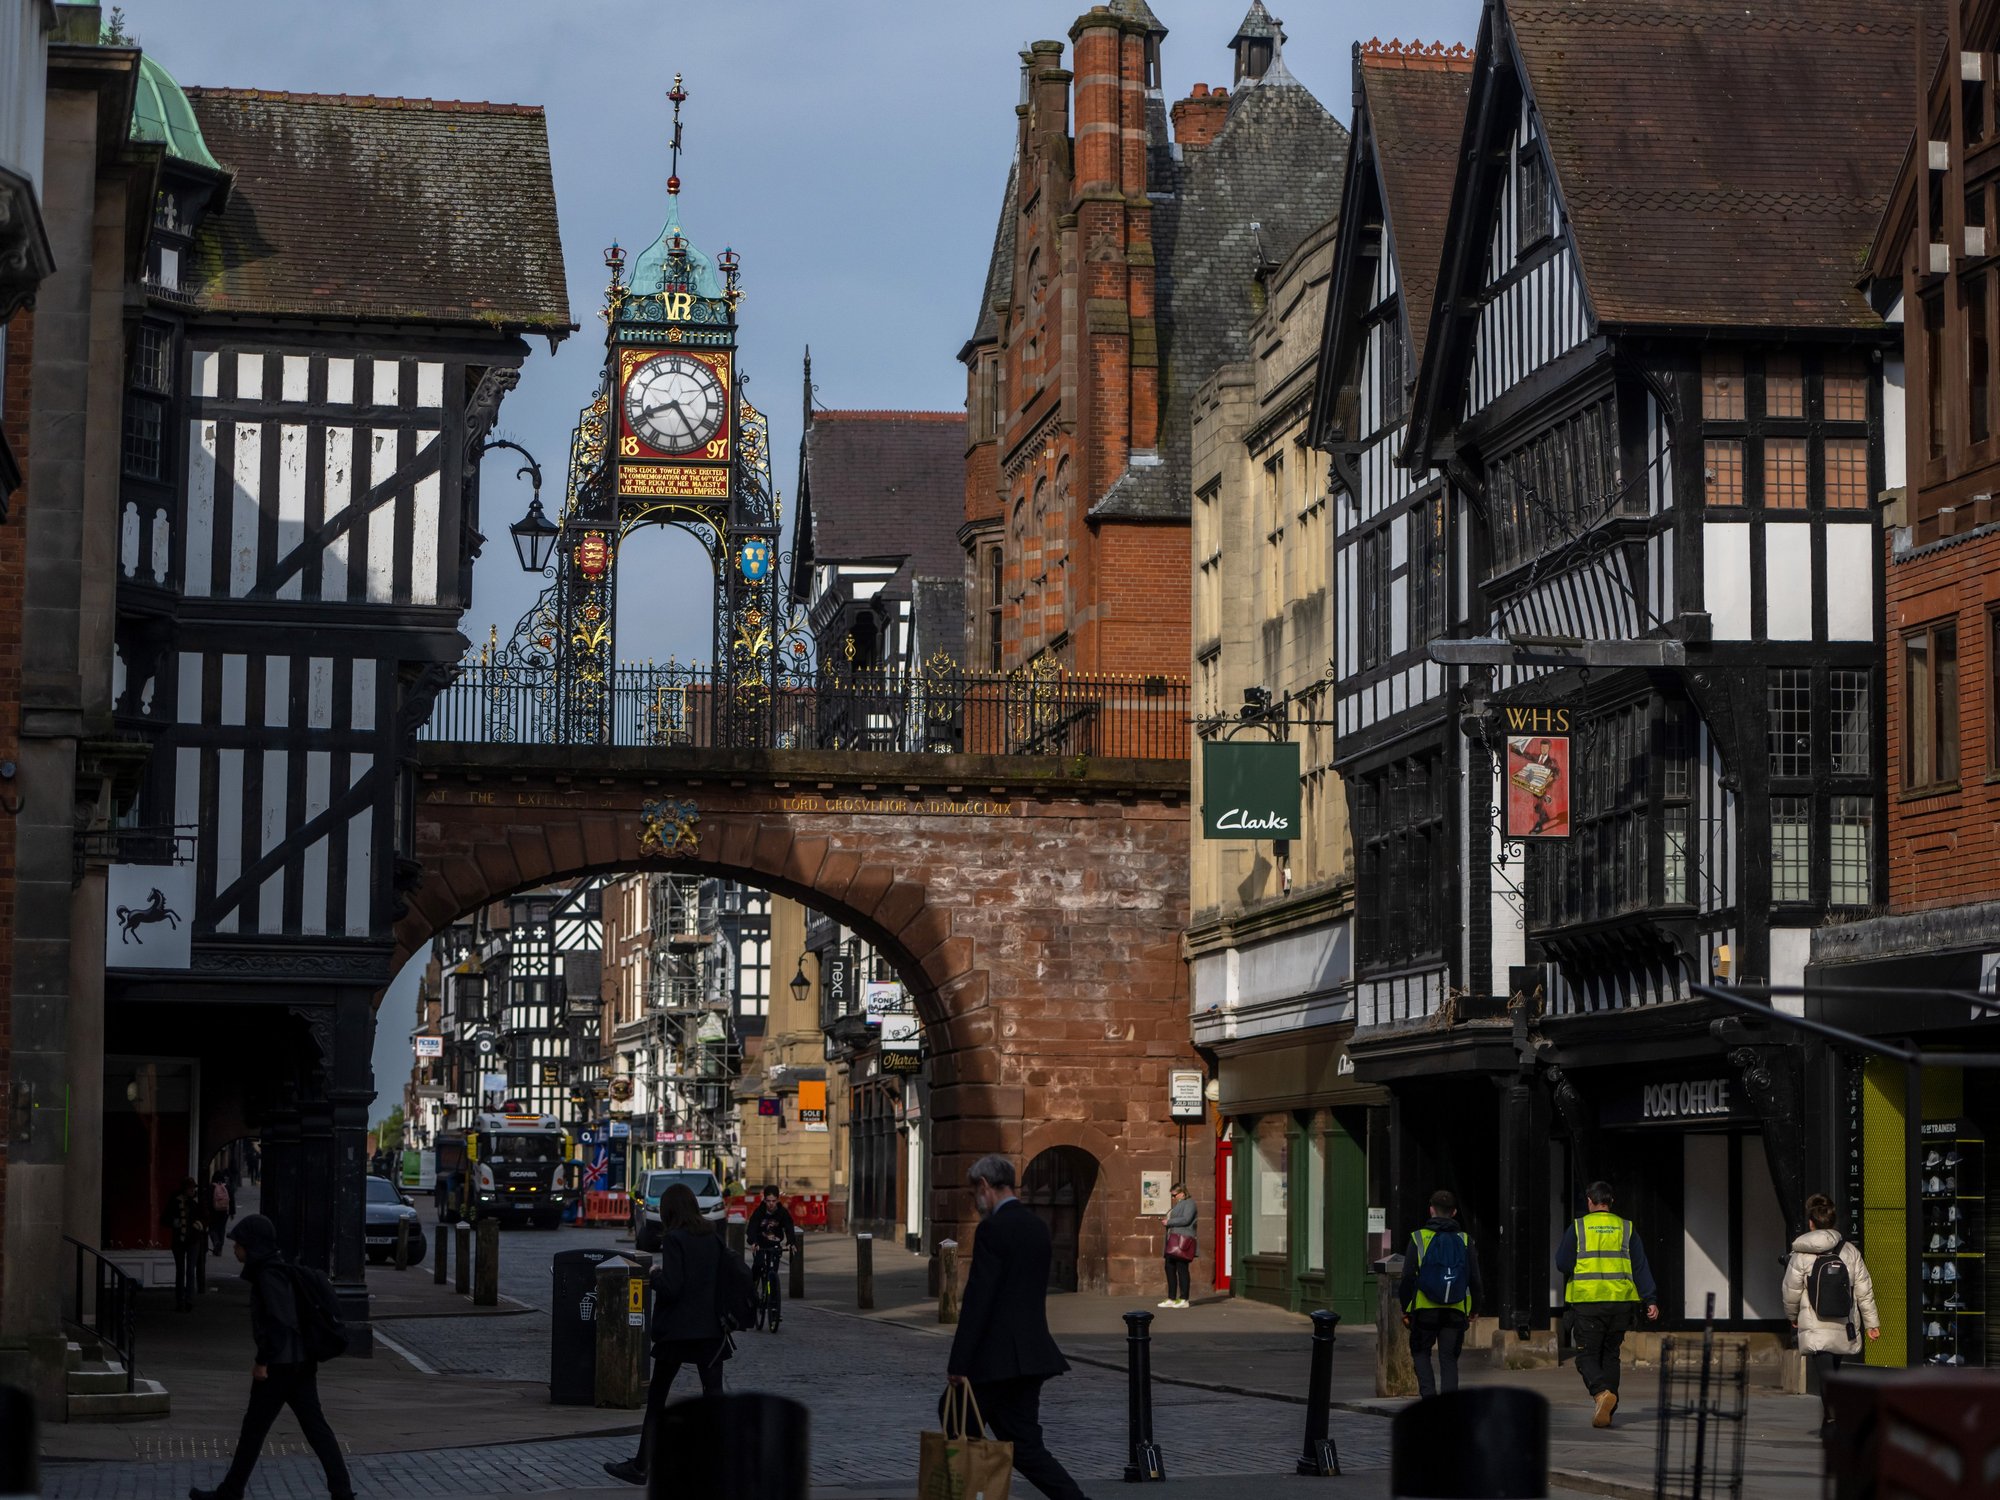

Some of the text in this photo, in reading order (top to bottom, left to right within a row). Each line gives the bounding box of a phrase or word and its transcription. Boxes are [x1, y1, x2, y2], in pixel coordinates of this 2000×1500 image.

[662, 292, 692, 321] VR
[628, 473, 680, 481] COMMEMORATION
[621, 485, 655, 493] VICTORIA
[694, 487, 726, 495] EMPRESS
[469, 791, 496, 804] THE
[783, 798, 818, 811] LORD
[825, 798, 907, 812] GROSVENOR
[1216, 808, 1289, 830] Clarks
[831, 961, 844, 998] next
[1643, 1078, 1730, 1117] POST OFFICE
[1932, 1123, 1957, 1134] TRAINERS
